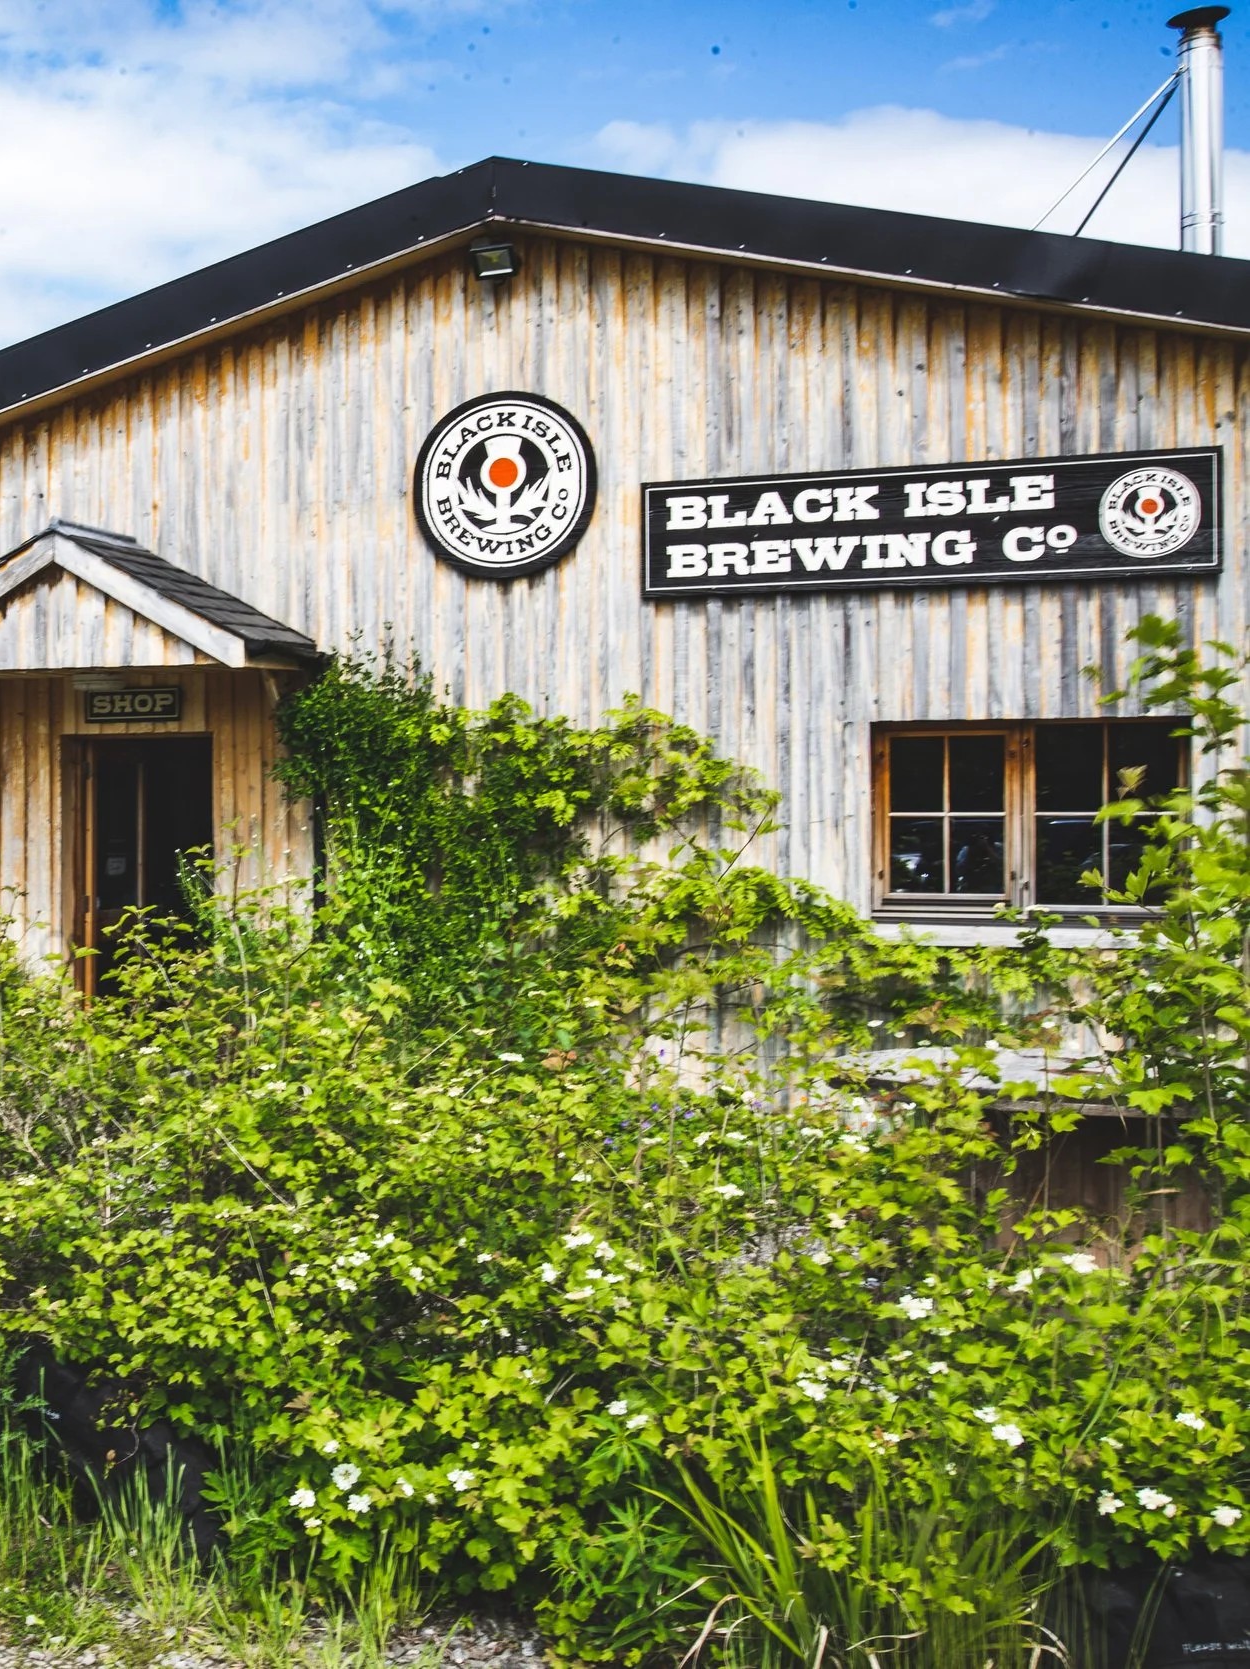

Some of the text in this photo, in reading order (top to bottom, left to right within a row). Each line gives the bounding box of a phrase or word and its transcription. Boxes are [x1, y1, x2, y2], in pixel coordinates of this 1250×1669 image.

[435, 411, 573, 480] BLACK ISLE
[665, 474, 1055, 531] BLACK ISLE
[1108, 473, 1192, 510] BLACK ISLE
[436, 495, 553, 556] BREWING
[1109, 519, 1180, 552] BREWING
[665, 529, 978, 579] BREWING
[92, 693, 174, 714] SHOP
